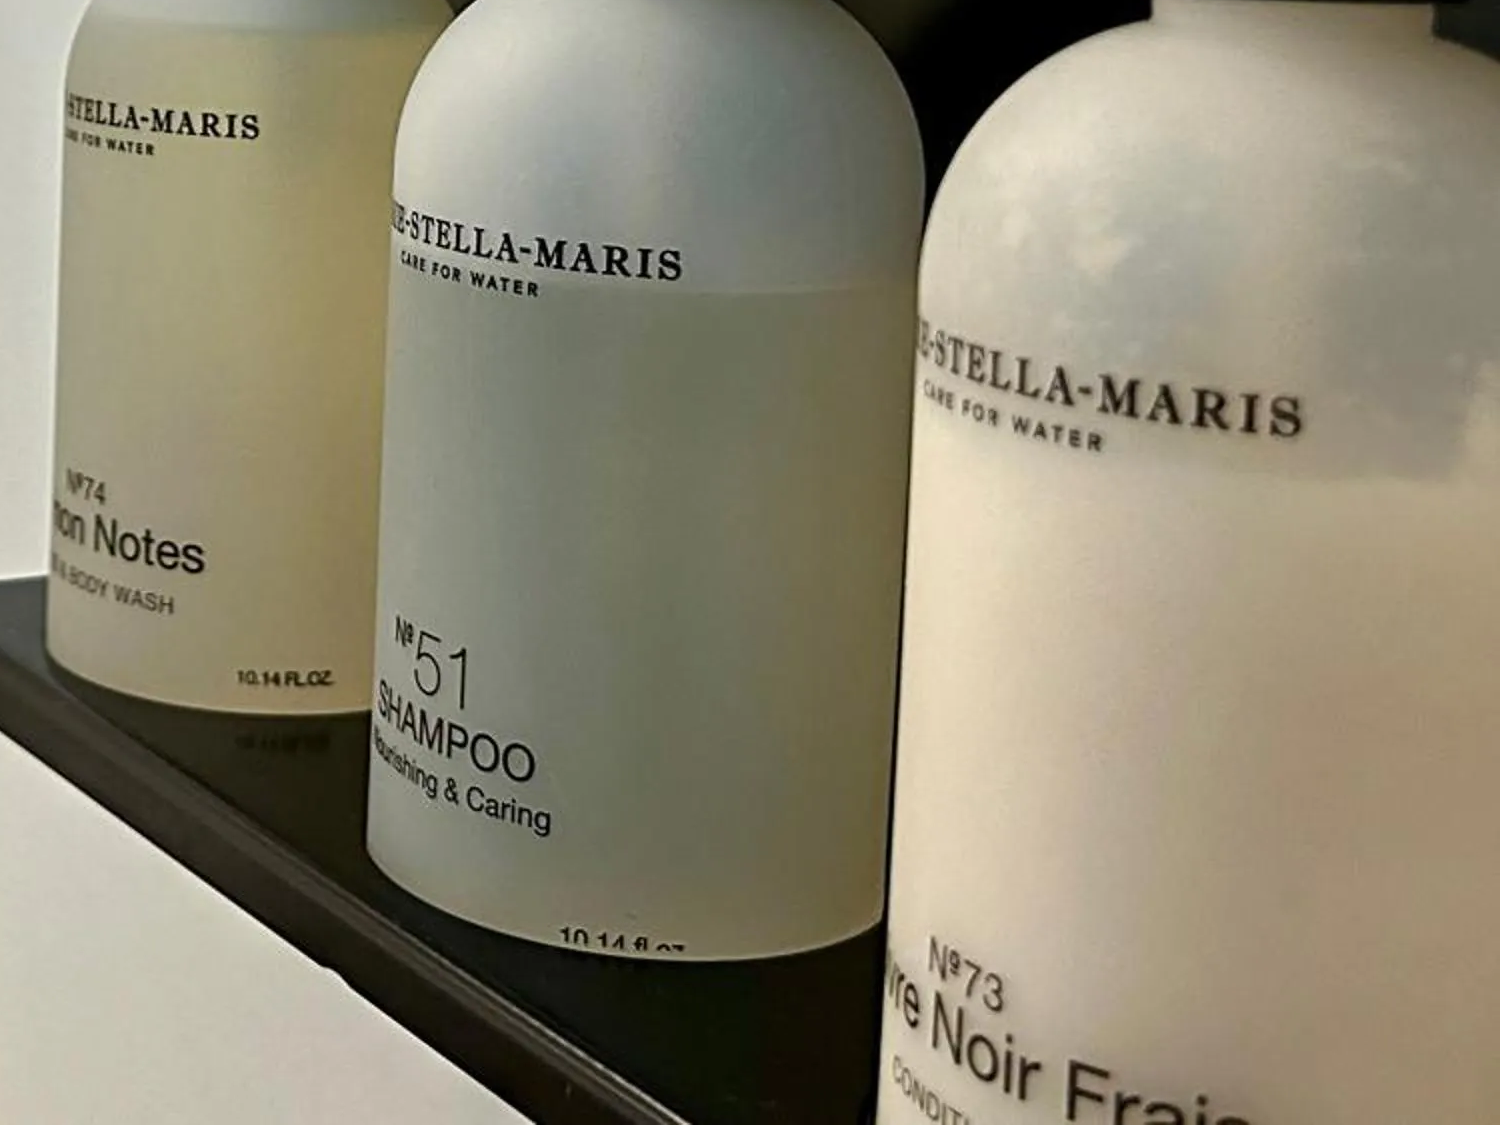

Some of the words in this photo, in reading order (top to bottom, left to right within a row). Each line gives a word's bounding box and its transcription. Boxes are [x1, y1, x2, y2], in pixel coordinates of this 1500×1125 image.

[106, 138, 155, 156] WATER
[393, 203, 683, 282] E-STELLA-MARIS
[401, 249, 426, 273] CARE
[431, 261, 461, 283] FOR
[469, 270, 539, 297] WATER
[919, 317, 1303, 438] E-STELLA-MARIS
[924, 379, 954, 411] CARE
[961, 399, 999, 427] FOR
[1011, 414, 1102, 452] WATER
[93, 513, 206, 575] Notes
[113, 584, 175, 615] WASH
[379, 679, 536, 783] SHAMPOO
[444, 777, 460, 806] &
[466, 786, 551, 837] Caring
[892, 1055, 972, 1125] CONDIT
[932, 990, 1042, 1101] Noir
[1066, 1059, 1250, 1125] Frai
